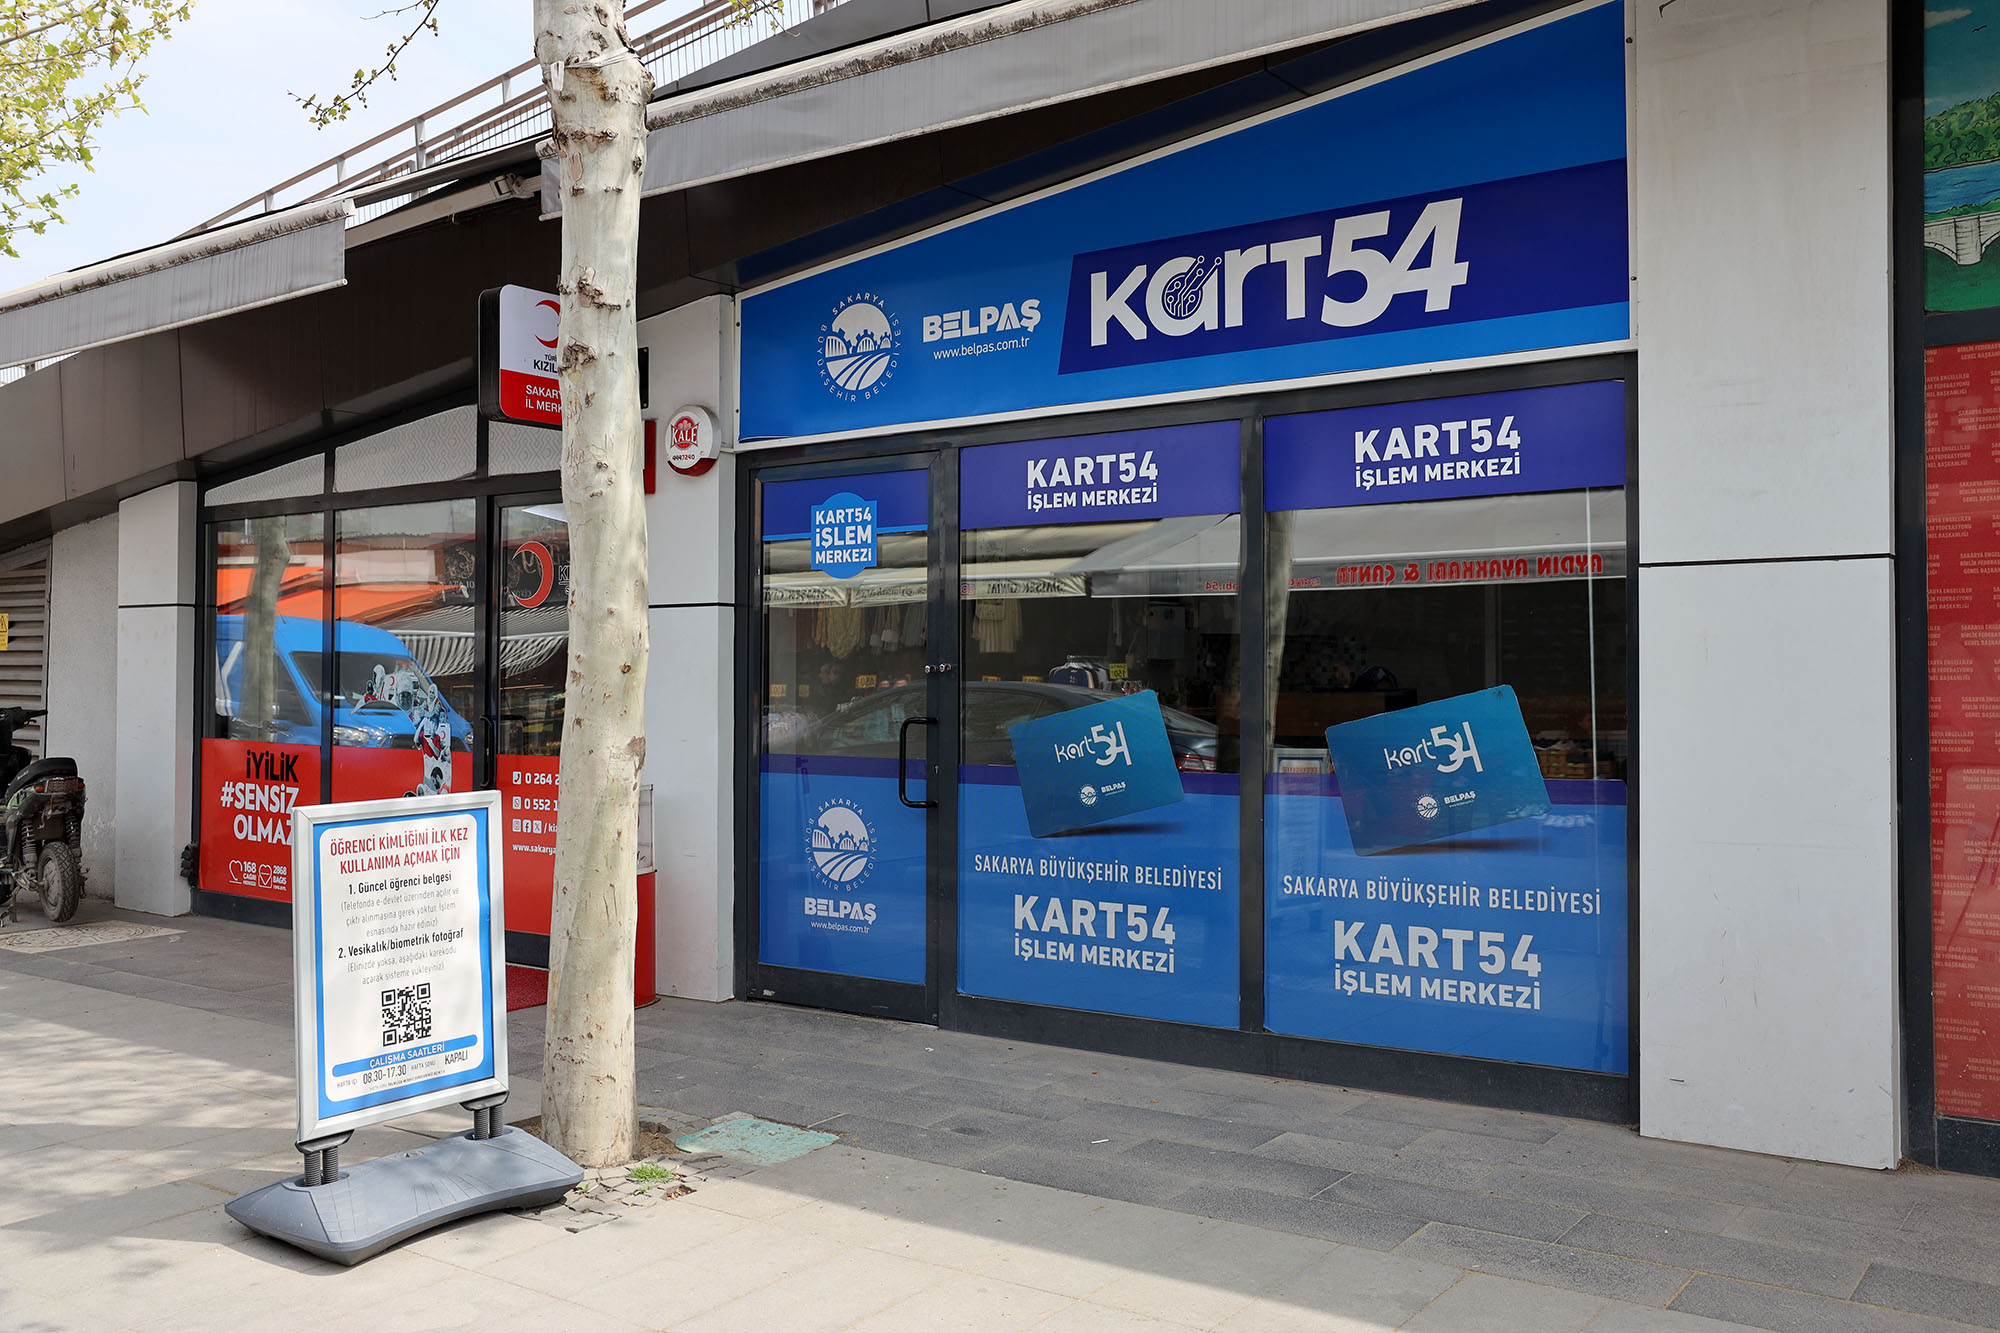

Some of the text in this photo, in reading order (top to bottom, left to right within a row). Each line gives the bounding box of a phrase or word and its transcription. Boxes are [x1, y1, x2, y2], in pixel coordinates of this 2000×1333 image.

[832, 292, 885, 316] SAKARYA
[923, 299, 1041, 343] BELPAŞ
[933, 336, 1030, 360] www.belpas.com.tr
[525, 384, 560, 399] SAKAR
[525, 396, 534, 409] İL
[672, 425, 699, 446] KALE
[1354, 415, 1520, 464] KART54
[1027, 450, 1158, 489] KART54
[1355, 451, 1520, 490] İŞLEM MERKEZİ
[1027, 482, 1157, 513] İŞLEM MERKEZİ
[816, 507, 872, 525] KART54
[816, 524, 872, 549] İŞLEM
[816, 548, 872, 564] MERKEZİ
[246, 749, 299, 783] İYİLİK
[525, 772, 531, 784] 0
[534, 773, 552, 785] 264
[220, 781, 299, 814] #SENSİZ
[524, 798, 531, 809] 0
[533, 799, 550, 810] 552
[818, 797, 864, 816] SAKARYA
[330, 827, 468, 856] ÖĞRENCİ KİMLİĞİNİ İLK KEZ
[243, 861, 256, 873] 168
[340, 844, 460, 875] KULLANIMA AÇMAK İÇİN
[974, 854, 1222, 890] SAKARYA BÜYÜKŞEHİR BELEDİYESİ
[349, 870, 452, 895] 1. Güncel öğrenci belgesi
[1283, 874, 1601, 915] SAKARYA BÜYÜKŞEHİR BELEDİYESİ
[804, 897, 877, 925] BELPAŞ
[1014, 894, 1176, 945] KART54
[810, 921, 870, 934] www.belpas.com.tr
[338, 927, 464, 959] 2. Vesikalık/biometrik fotoğraf
[1014, 933, 1175, 973] İŞLEM MERKEZİ
[1334, 920, 1541, 978] KART54
[1334, 964, 1541, 1010] İŞLEM MERKEZİ
[369, 1041, 445, 1068] ÇALIŞMA SAATLERİ
[445, 1050, 468, 1065] KAPALI
